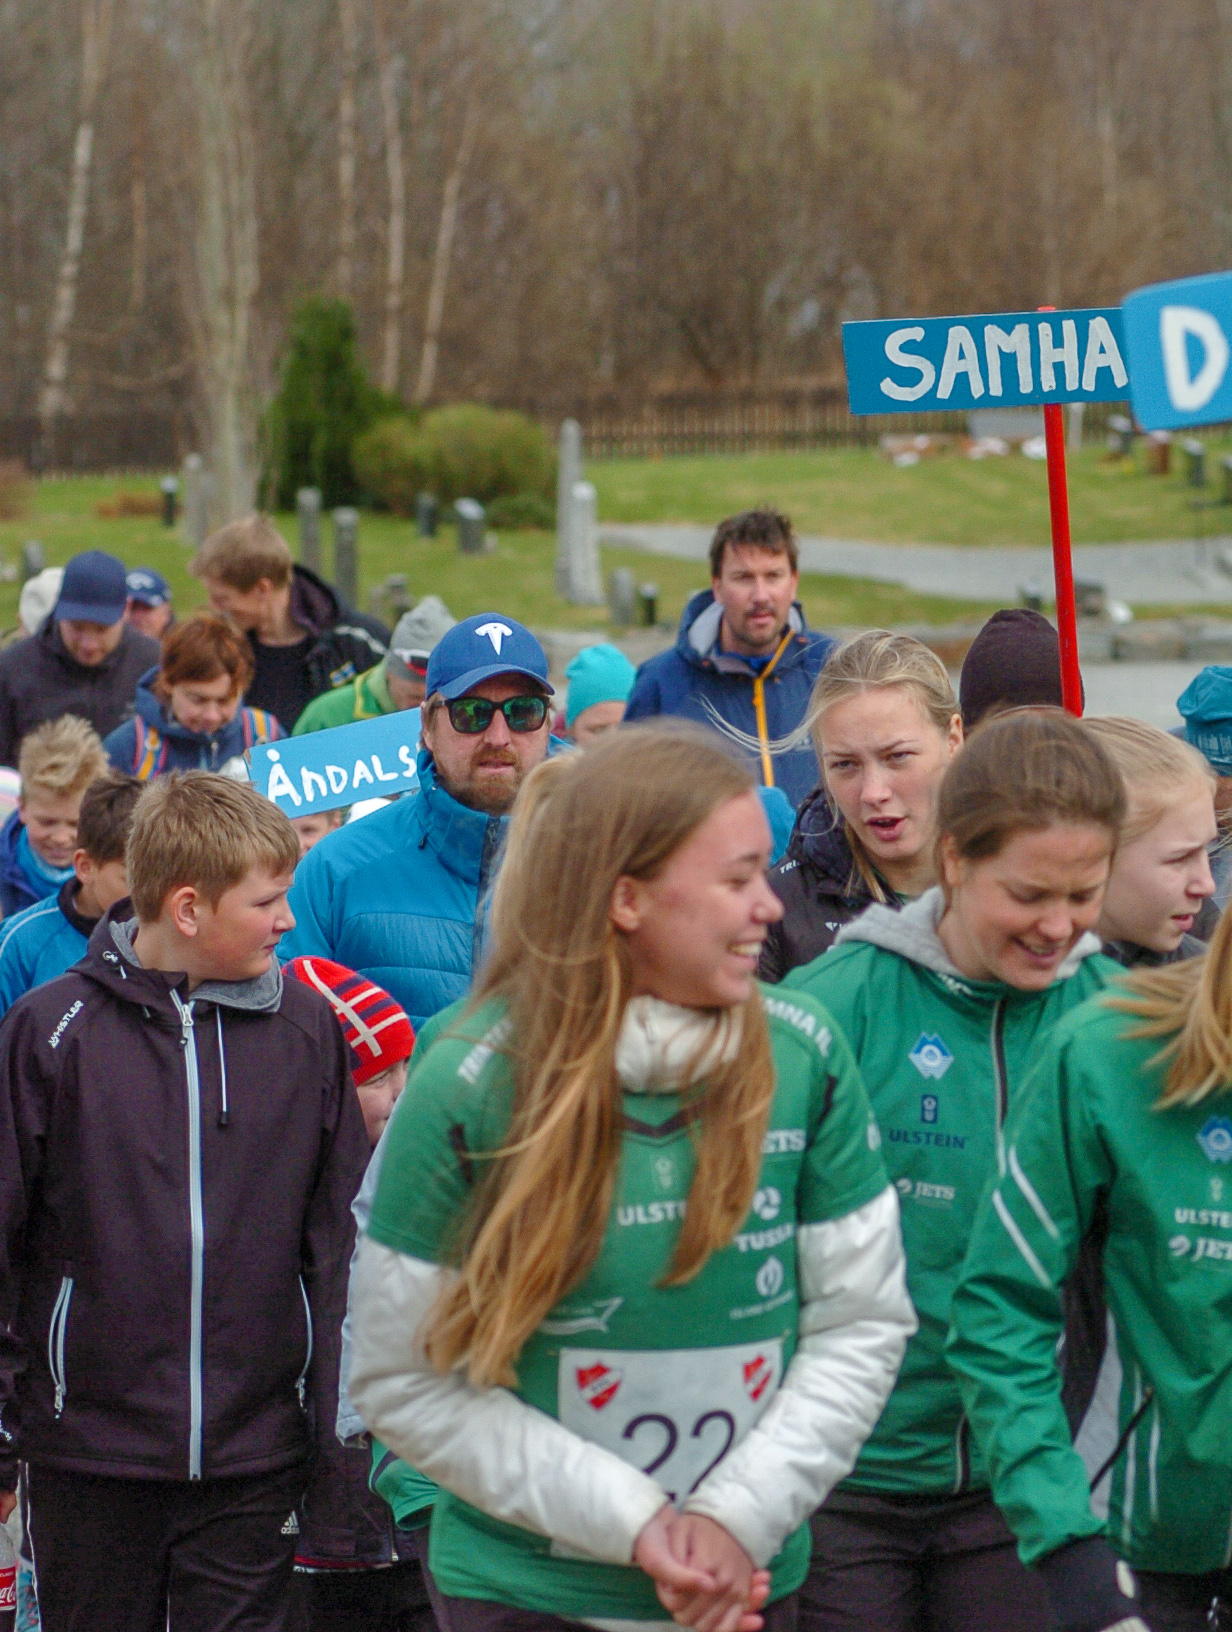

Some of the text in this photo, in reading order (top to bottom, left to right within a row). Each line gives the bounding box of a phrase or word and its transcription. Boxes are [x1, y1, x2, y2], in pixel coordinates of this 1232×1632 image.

[879, 316, 1129, 402] SAMHA
[266, 741, 420, 807] ÅnDALS
[48, 1000, 84, 1049] WHISTLER
[759, 1129, 807, 1154] ETS
[888, 1130, 967, 1150] ULSTEIN
[621, 1409, 736, 1502] 22
